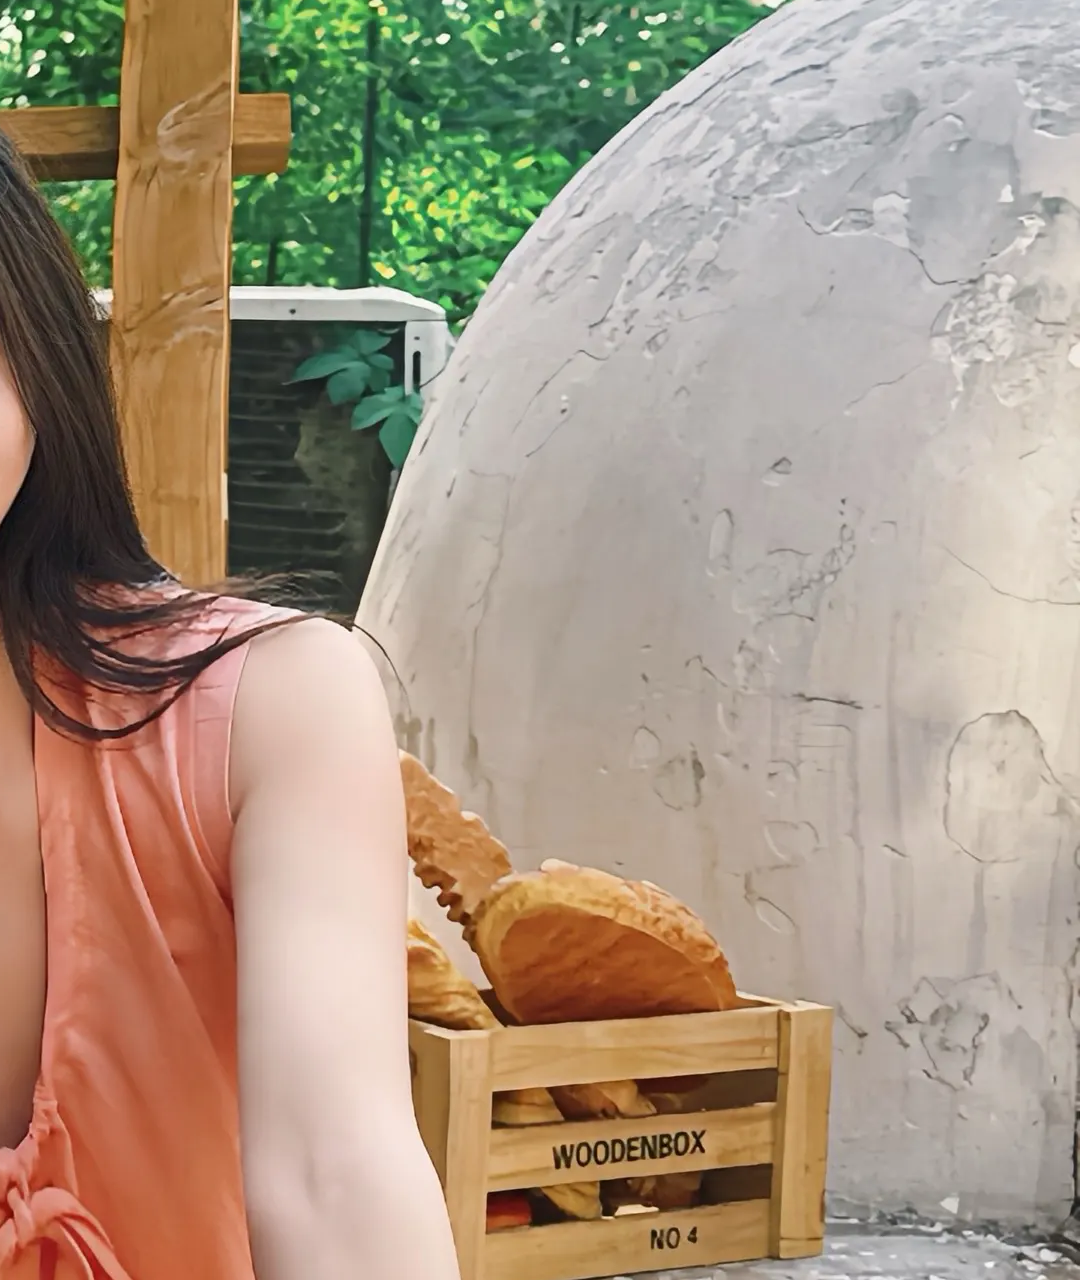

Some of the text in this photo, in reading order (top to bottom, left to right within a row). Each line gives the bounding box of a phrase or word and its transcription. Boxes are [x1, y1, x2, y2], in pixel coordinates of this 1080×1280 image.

[552, 1129, 707, 1171] WOODENBOX
[650, 1226, 698, 1250] NO 4
